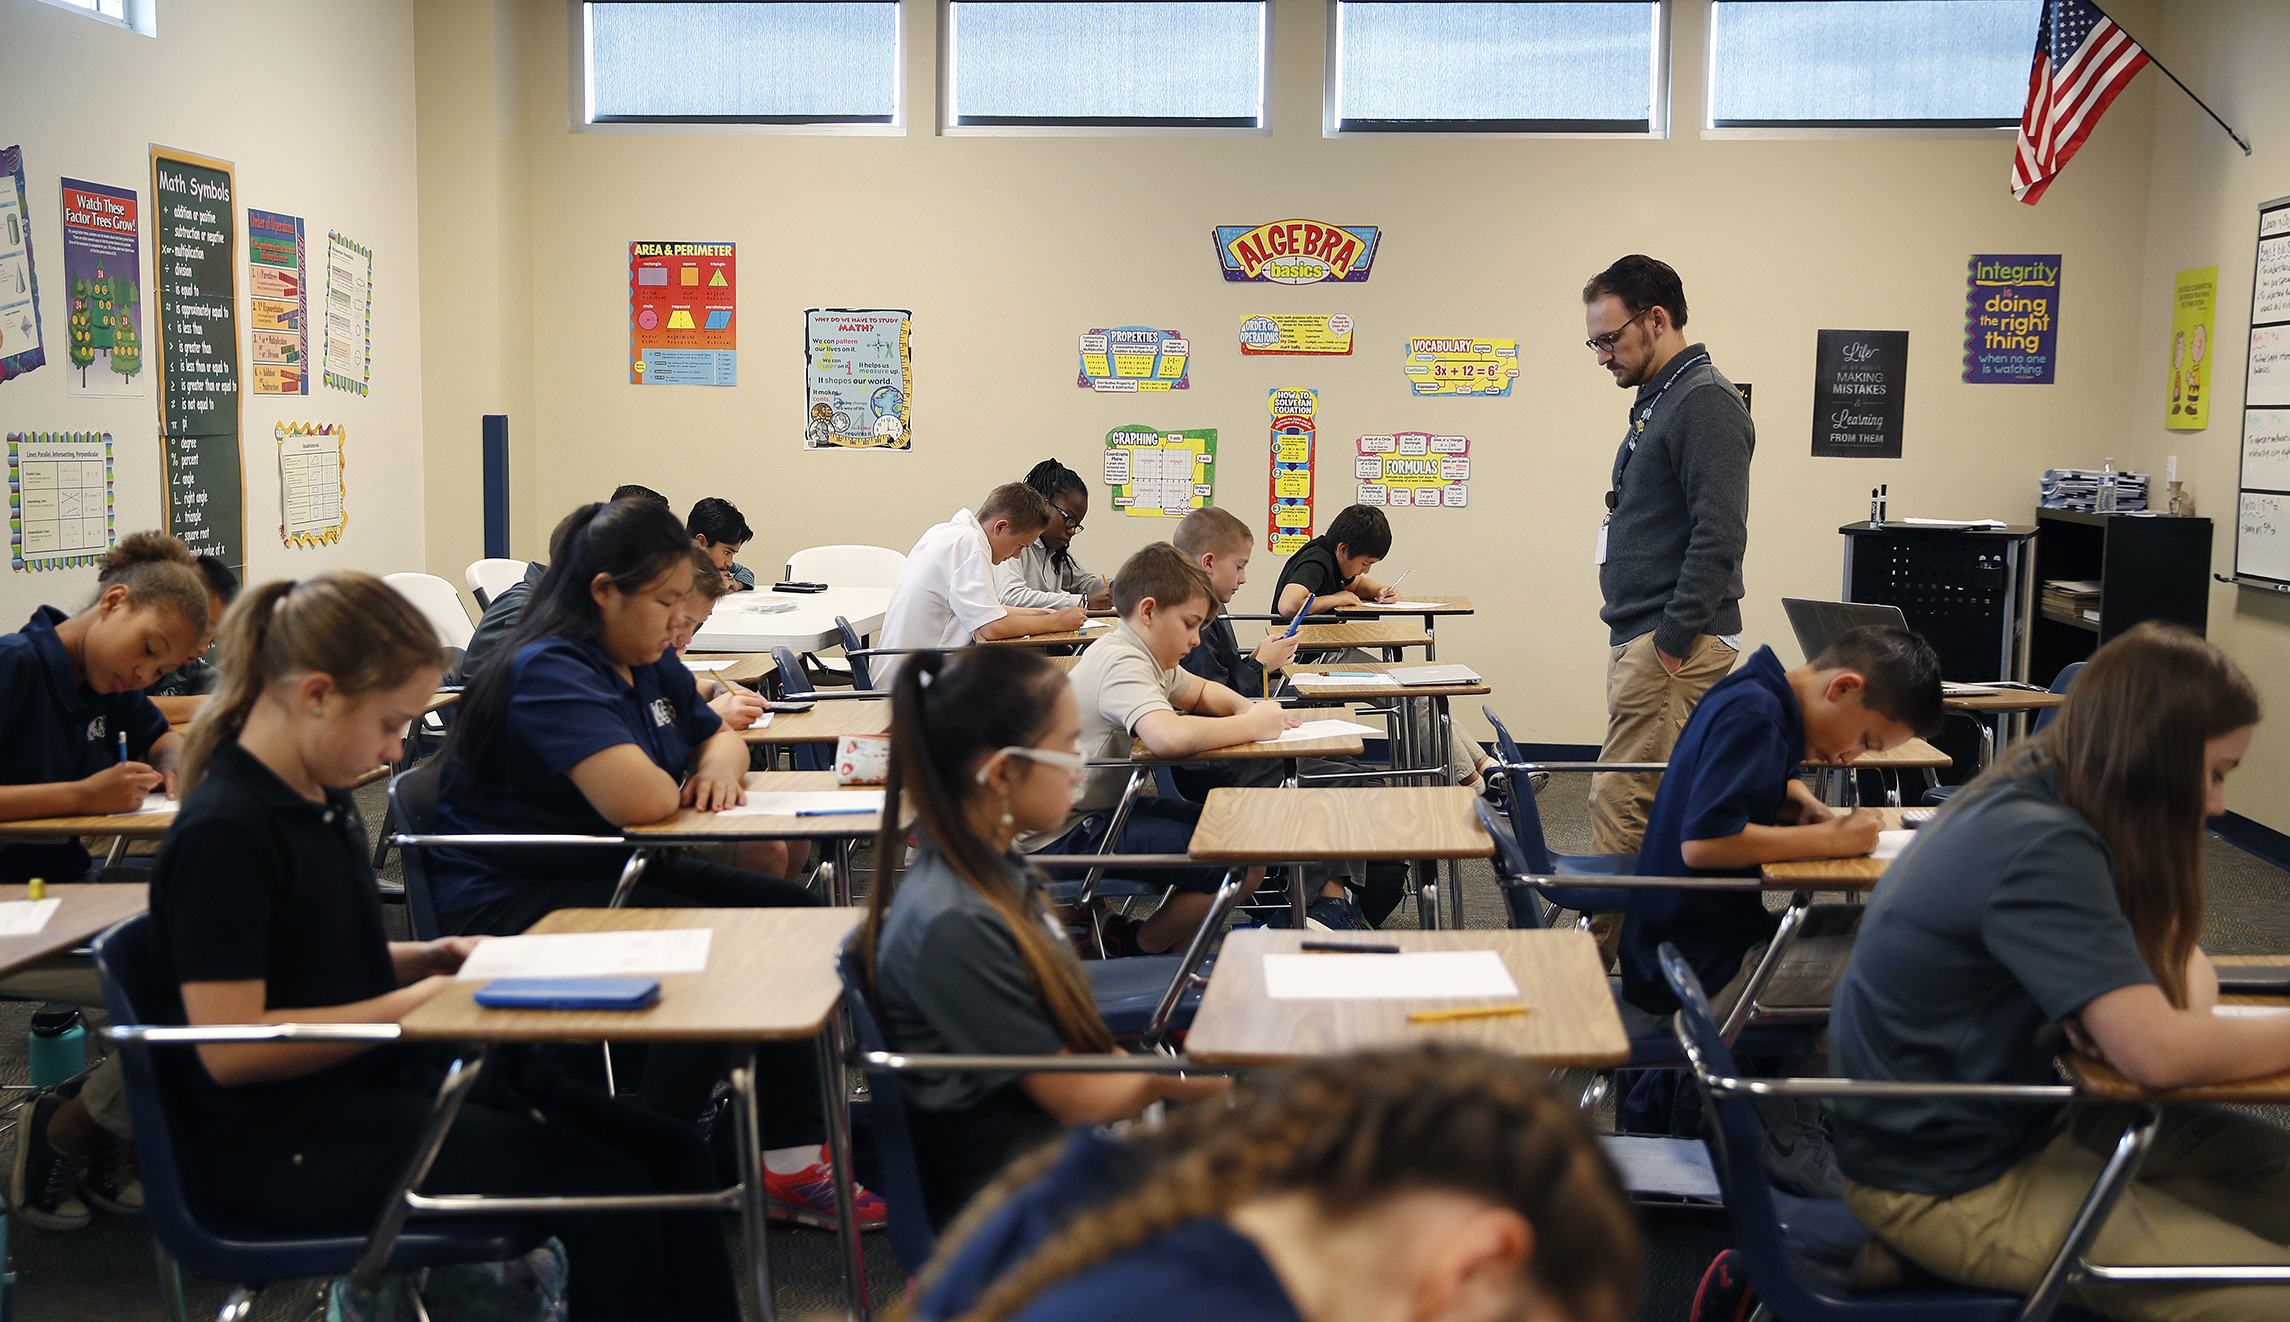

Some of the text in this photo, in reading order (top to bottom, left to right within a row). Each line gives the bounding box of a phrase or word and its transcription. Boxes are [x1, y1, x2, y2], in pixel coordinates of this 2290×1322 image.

[160, 171, 230, 203] Math Symbols
[77, 194, 125, 216] Watch These
[66, 207, 136, 232] Factor Trees Grow!
[174, 204, 216, 225] addition or positive
[251, 212, 265, 229] Order
[271, 215, 295, 236] Operations
[175, 224, 225, 246] subtraction or negative
[175, 243, 205, 261] multiplication
[634, 244, 733, 257] AREA & PERIMETER
[1236, 224, 1356, 273] ALGEBRA
[175, 262, 192, 277] division
[1270, 261, 1323, 279] basics
[1976, 262, 2058, 285] Integrity
[175, 282, 199, 299] is equal to
[2003, 287, 2013, 298] is
[176, 301, 229, 321] is approximately equal to
[1984, 294, 2047, 317] doing
[177, 320, 203, 335] is less than
[838, 324, 874, 332] MATH?
[1245, 319, 1267, 332] ORDER
[1267, 320, 1277, 332] OF
[1980, 314, 2050, 336] the right
[1110, 330, 1159, 344] PROPERTIES
[1239, 331, 1280, 344] OPERATIONS
[1984, 331, 2040, 354] thing
[178, 340, 213, 357] is greater than
[1413, 339, 1474, 353] VOCABULARY
[1842, 342, 1879, 362] Life
[1978, 353, 2046, 363] when no one
[180, 359, 185, 372] is
[185, 358, 195, 372] less
[195, 358, 206, 373] than
[212, 360, 223, 376] equal
[223, 361, 229, 374] to
[1435, 365, 1446, 376] 3x
[1463, 365, 1474, 376] 12
[1982, 364, 1991, 373] is
[825, 377, 852, 385] shapes
[868, 377, 893, 385] world.
[1836, 372, 1883, 382] MAKING
[181, 378, 186, 391] is
[187, 379, 204, 395] greater
[205, 378, 215, 392] than
[221, 378, 232, 395] equal
[232, 380, 237, 392] to
[1277, 391, 1310, 399] HOW TO
[1832, 384, 1887, 395] MISTAKES
[182, 396, 215, 413] is not equal to
[1275, 399, 1312, 407] SOLVE AN
[1275, 406, 1312, 415] EQUATION
[1854, 399, 1861, 407] &
[182, 415, 188, 432] pi
[1831, 408, 1884, 431] Learning
[181, 436, 197, 452] degree
[1112, 432, 1159, 447] GRAPHING
[1830, 433, 1884, 443] FROM THEM
[181, 453, 199, 469] percent
[1385, 460, 1438, 475] FORMULAS
[182, 471, 195, 488] angle
[183, 489, 208, 508] right angle
[185, 508, 202, 526] triangle
[185, 527, 210, 544] square root
